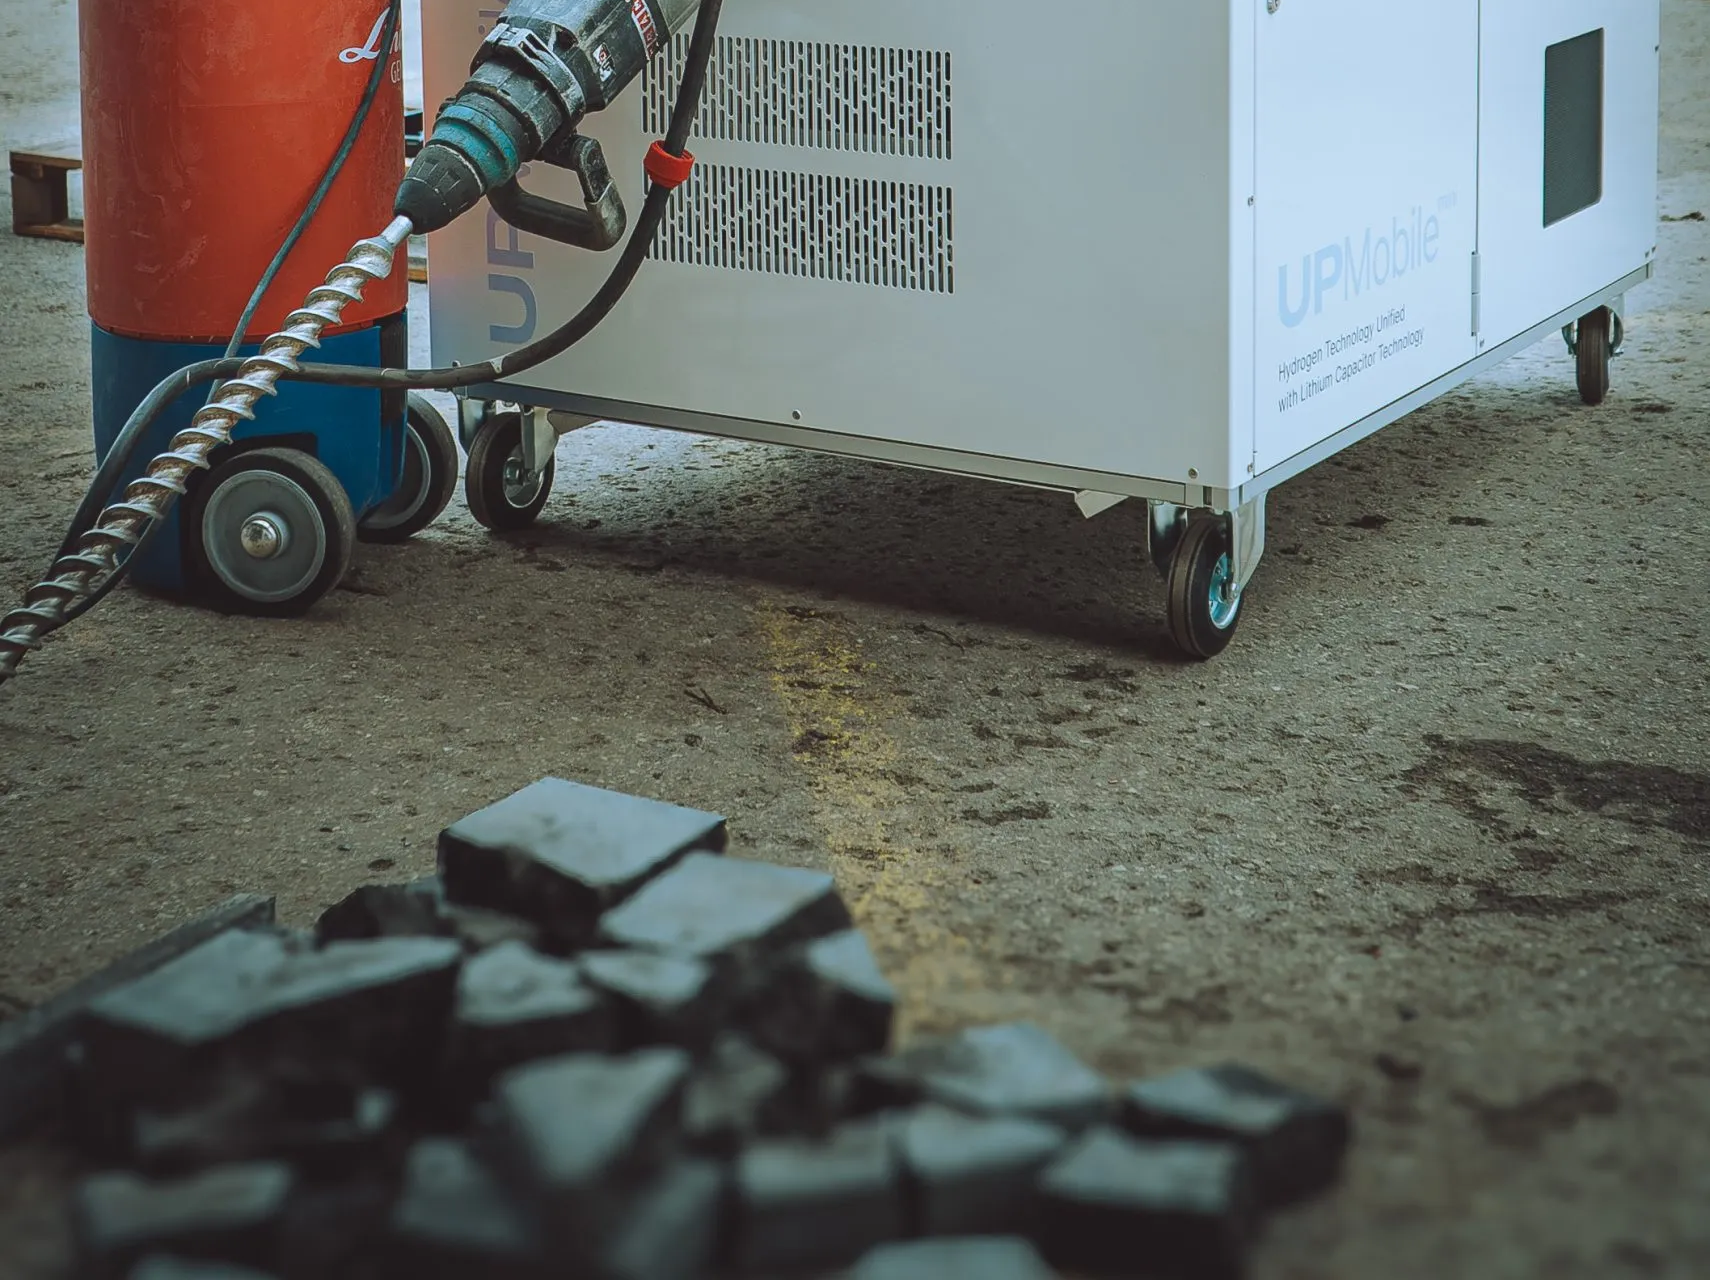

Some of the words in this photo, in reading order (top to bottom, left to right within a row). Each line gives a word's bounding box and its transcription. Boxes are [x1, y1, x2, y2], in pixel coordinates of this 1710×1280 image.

[1278, 347, 1322, 383] Hydrogen
[1325, 324, 1374, 357] Technology
[1376, 304, 1405, 333] Unified
[1278, 392, 1298, 413] with
[1300, 374, 1333, 400] Lithium
[1335, 352, 1376, 384] Capacitor
[1378, 327, 1424, 360] Technology
